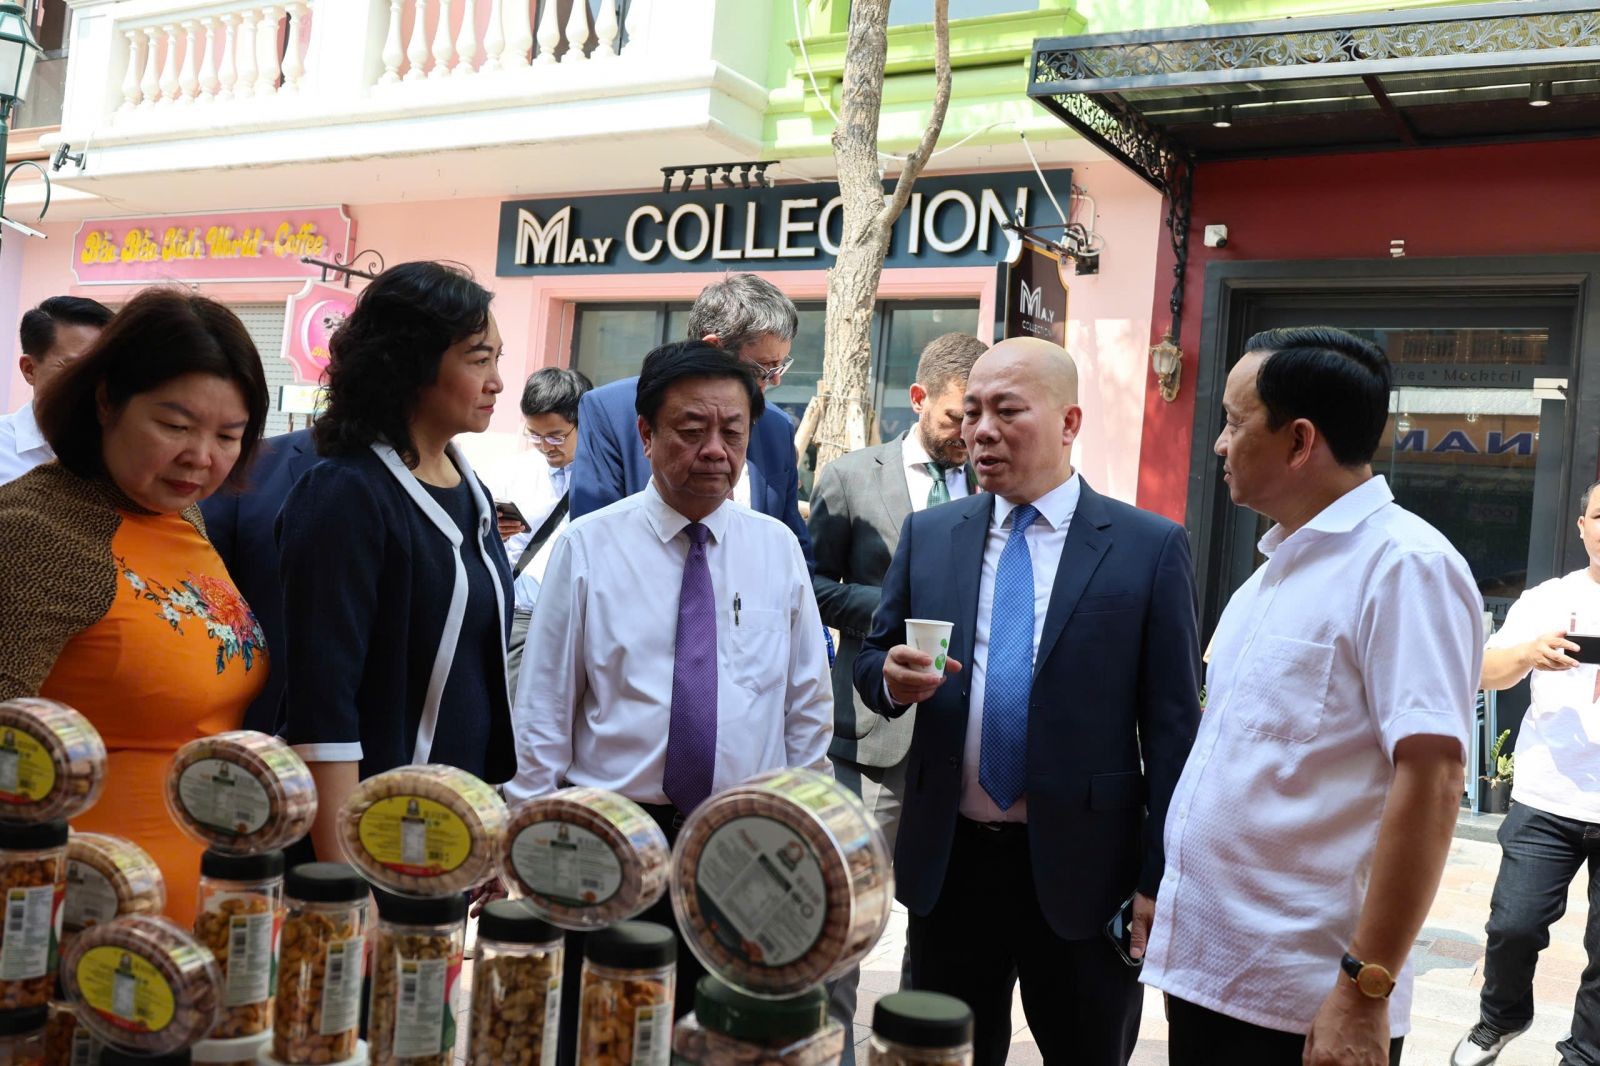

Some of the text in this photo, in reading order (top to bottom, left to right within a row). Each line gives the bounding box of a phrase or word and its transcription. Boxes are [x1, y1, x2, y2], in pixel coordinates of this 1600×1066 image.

[205, 224, 262, 257] World
[274, 220, 326, 257] Coffee
[625, 187, 1029, 262] COLLECION
[1443, 368, 1521, 383] Mocktail
